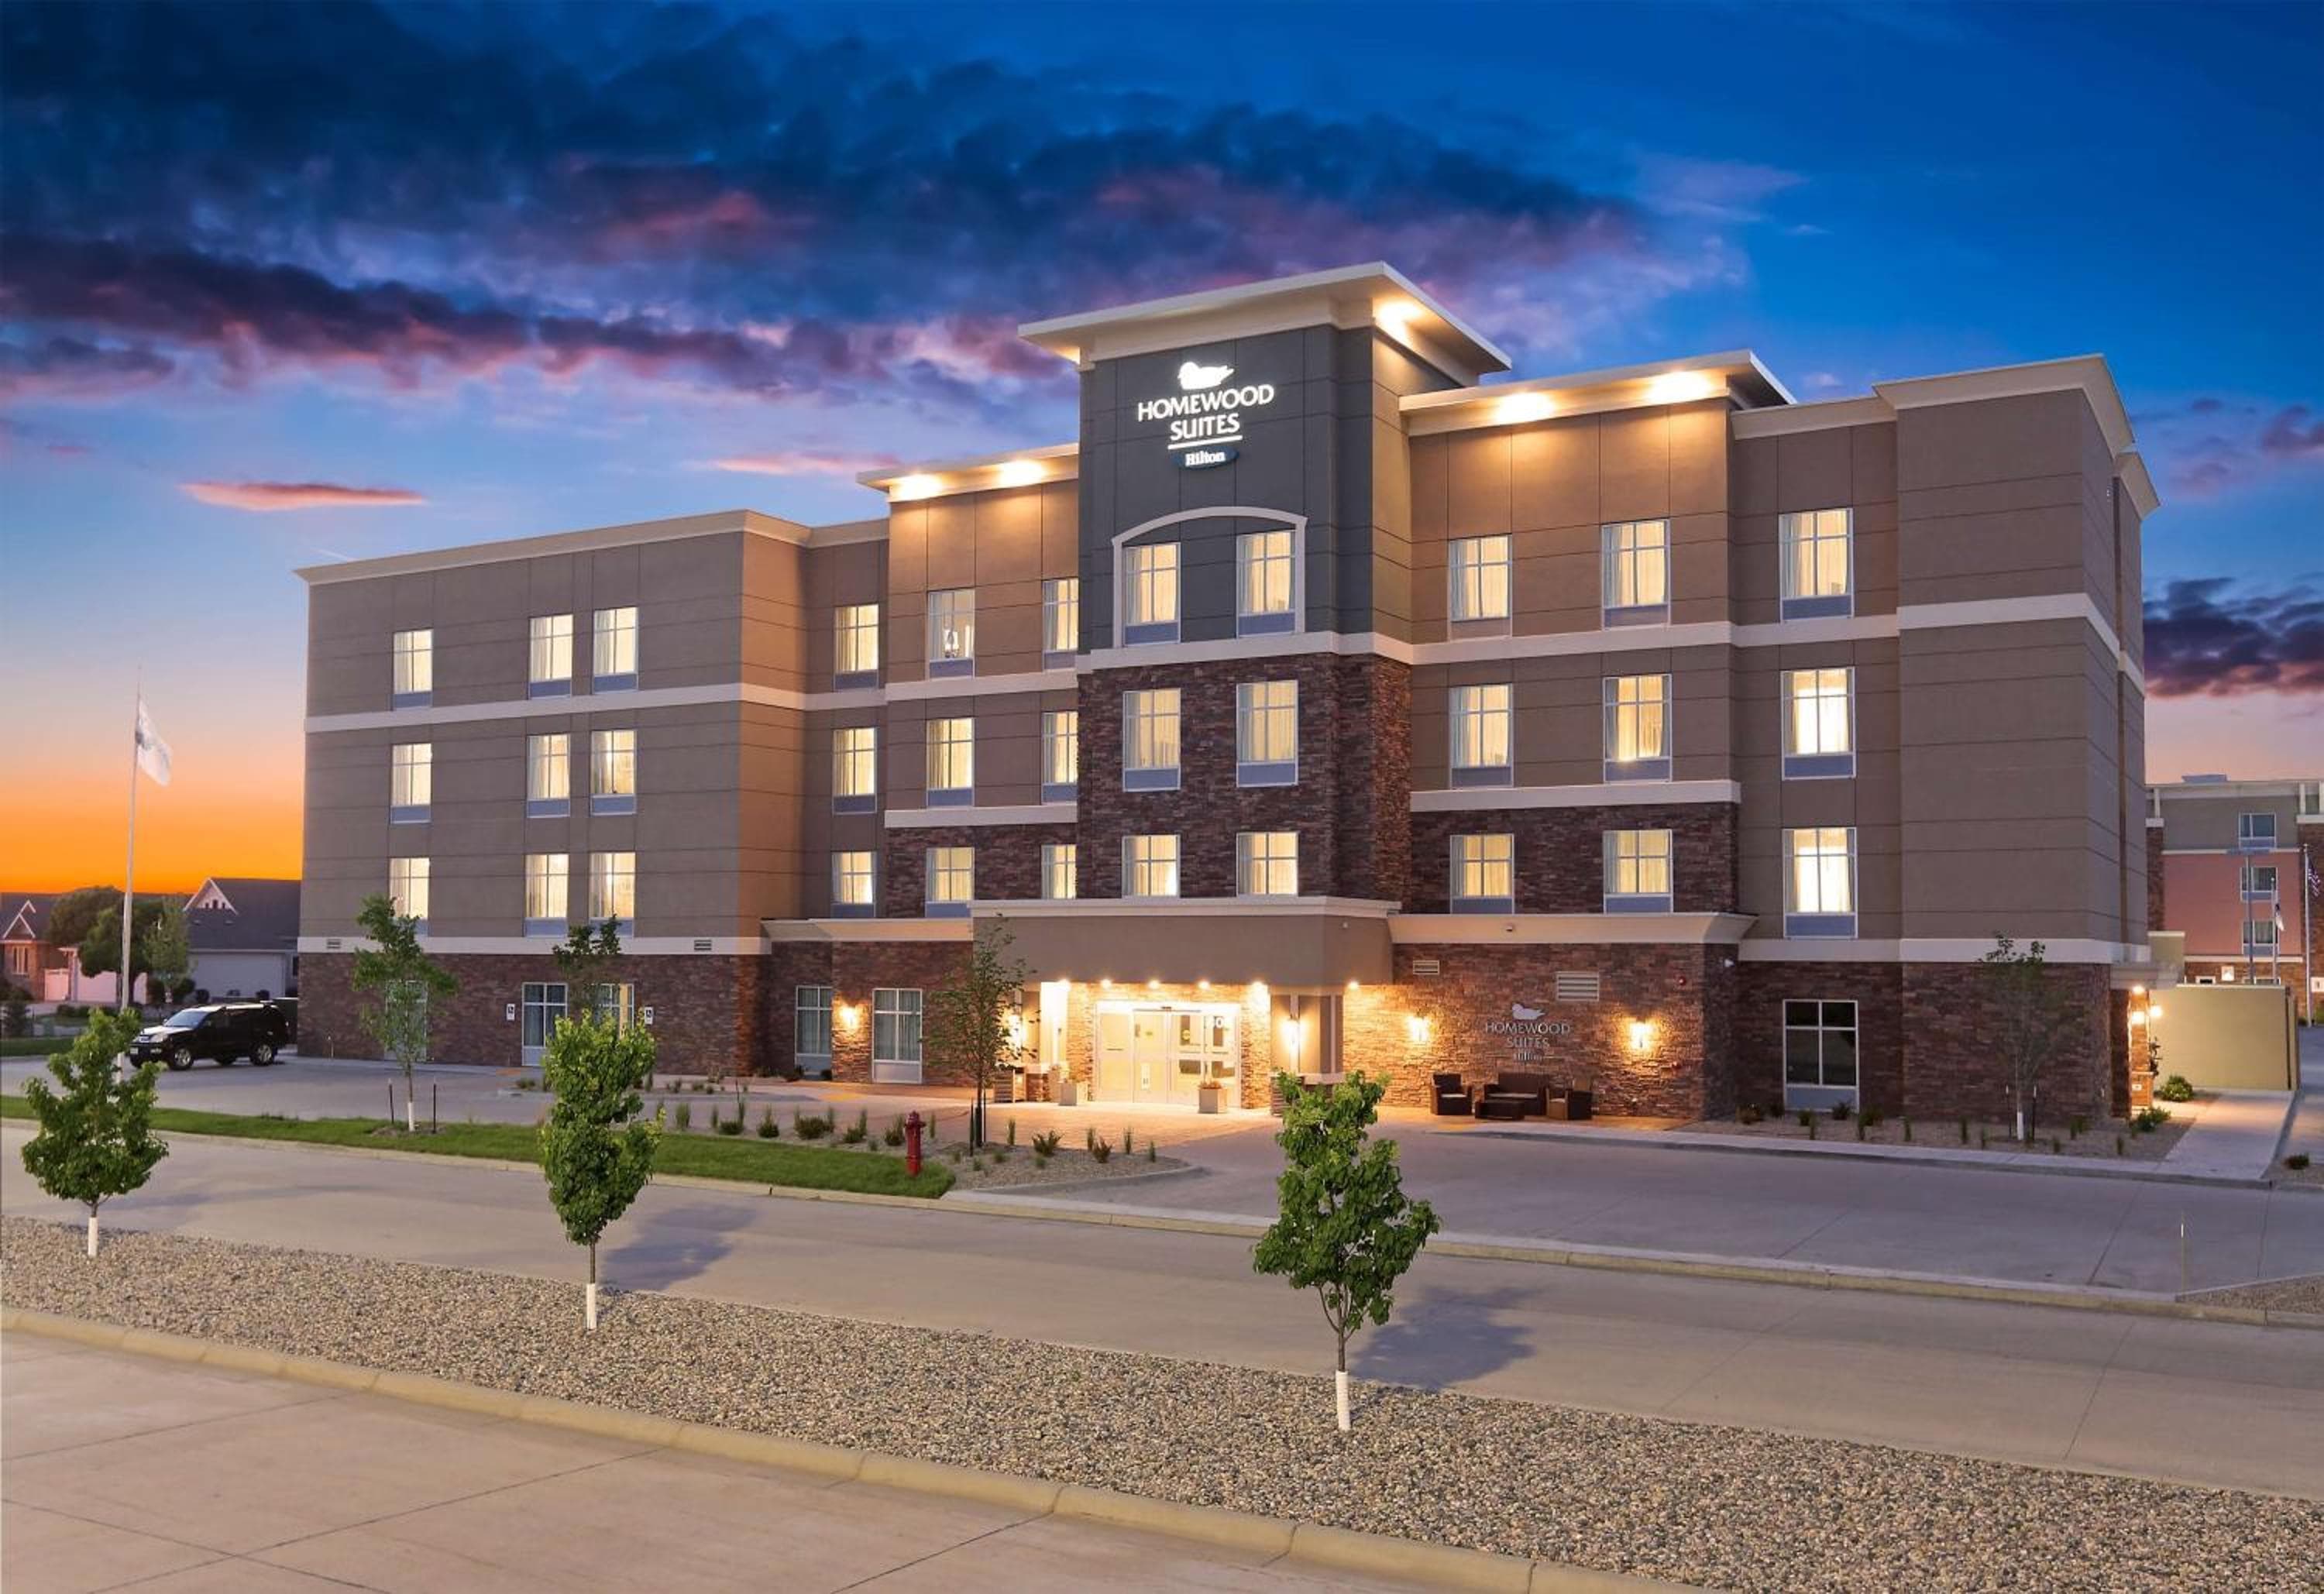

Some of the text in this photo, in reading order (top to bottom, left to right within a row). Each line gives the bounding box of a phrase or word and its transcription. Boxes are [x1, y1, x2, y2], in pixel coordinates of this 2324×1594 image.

[1138, 384, 1274, 421] HOMEWOOD
[1171, 413, 1240, 441] SUITES
[1185, 451, 1226, 466] Hilton
[1485, 1022, 1570, 1034] HOMEWOOD
[1507, 1037, 1549, 1048] SUITES
